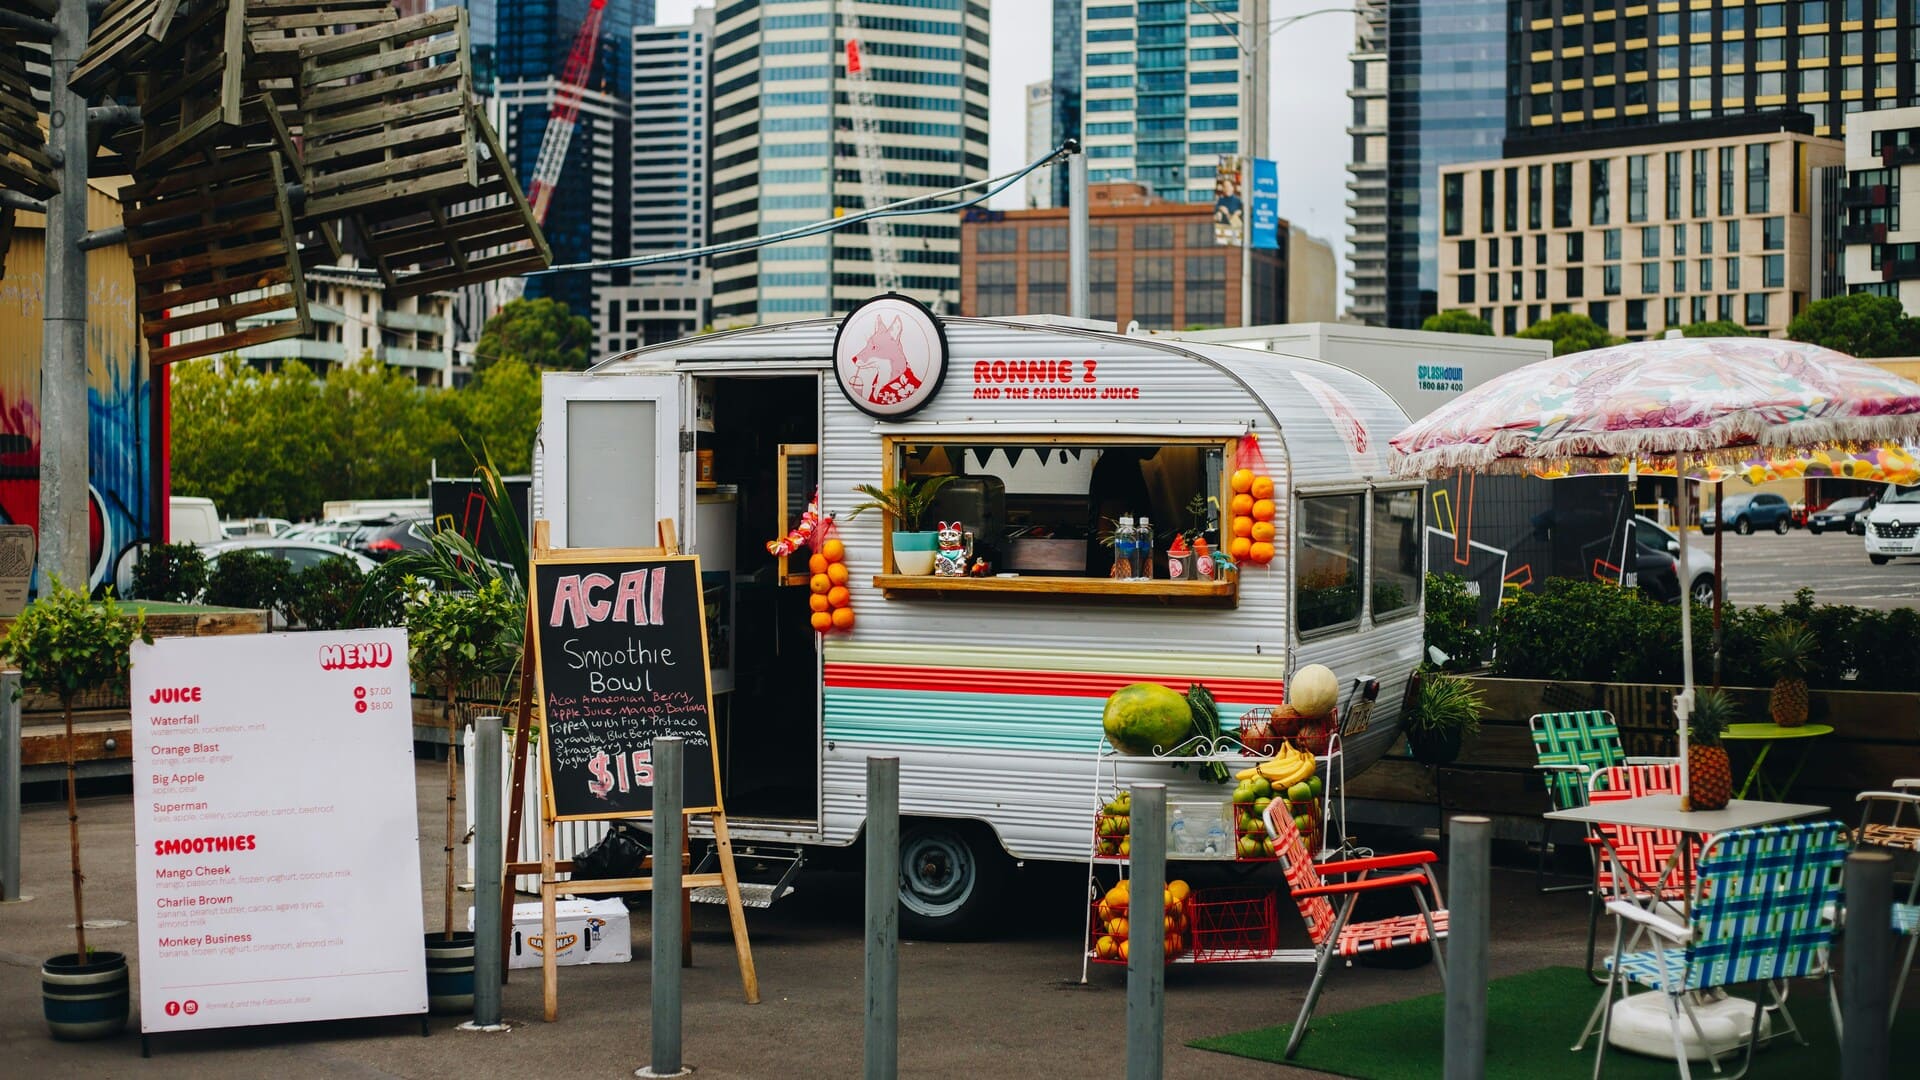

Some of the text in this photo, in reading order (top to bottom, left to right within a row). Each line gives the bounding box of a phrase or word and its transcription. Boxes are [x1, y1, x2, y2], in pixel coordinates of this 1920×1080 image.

[973, 359, 1097, 383] RONNIE Z
[973, 387, 1139, 399] AND THE FABULOUS JUICE
[550, 567, 666, 628] ACAI
[319, 642, 392, 671] MENU
[564, 637, 676, 669] Smoothie
[590, 670, 653, 692] Bowl
[149, 686, 202, 704] JUICE
[369, 687, 392, 696] $7.00
[653, 692, 694, 704] Berry,
[371, 701, 393, 710] $8.00
[584, 706, 617, 717] Juice,
[151, 714, 199, 726] Waterfall
[592, 718, 618, 728] with
[622, 717, 638, 729] Fig
[151, 743, 219, 756] Orange Blast
[152, 772, 205, 786] Big Apple
[588, 749, 653, 798] $15
[153, 801, 208, 814] Superman
[155, 835, 256, 856] SMOOTHIES
[156, 864, 231, 880] Mango Cheek
[156, 895, 233, 908] Charlie Brown
[159, 933, 252, 949] Monkey Business
[530, 936, 574, 949] BANAS
